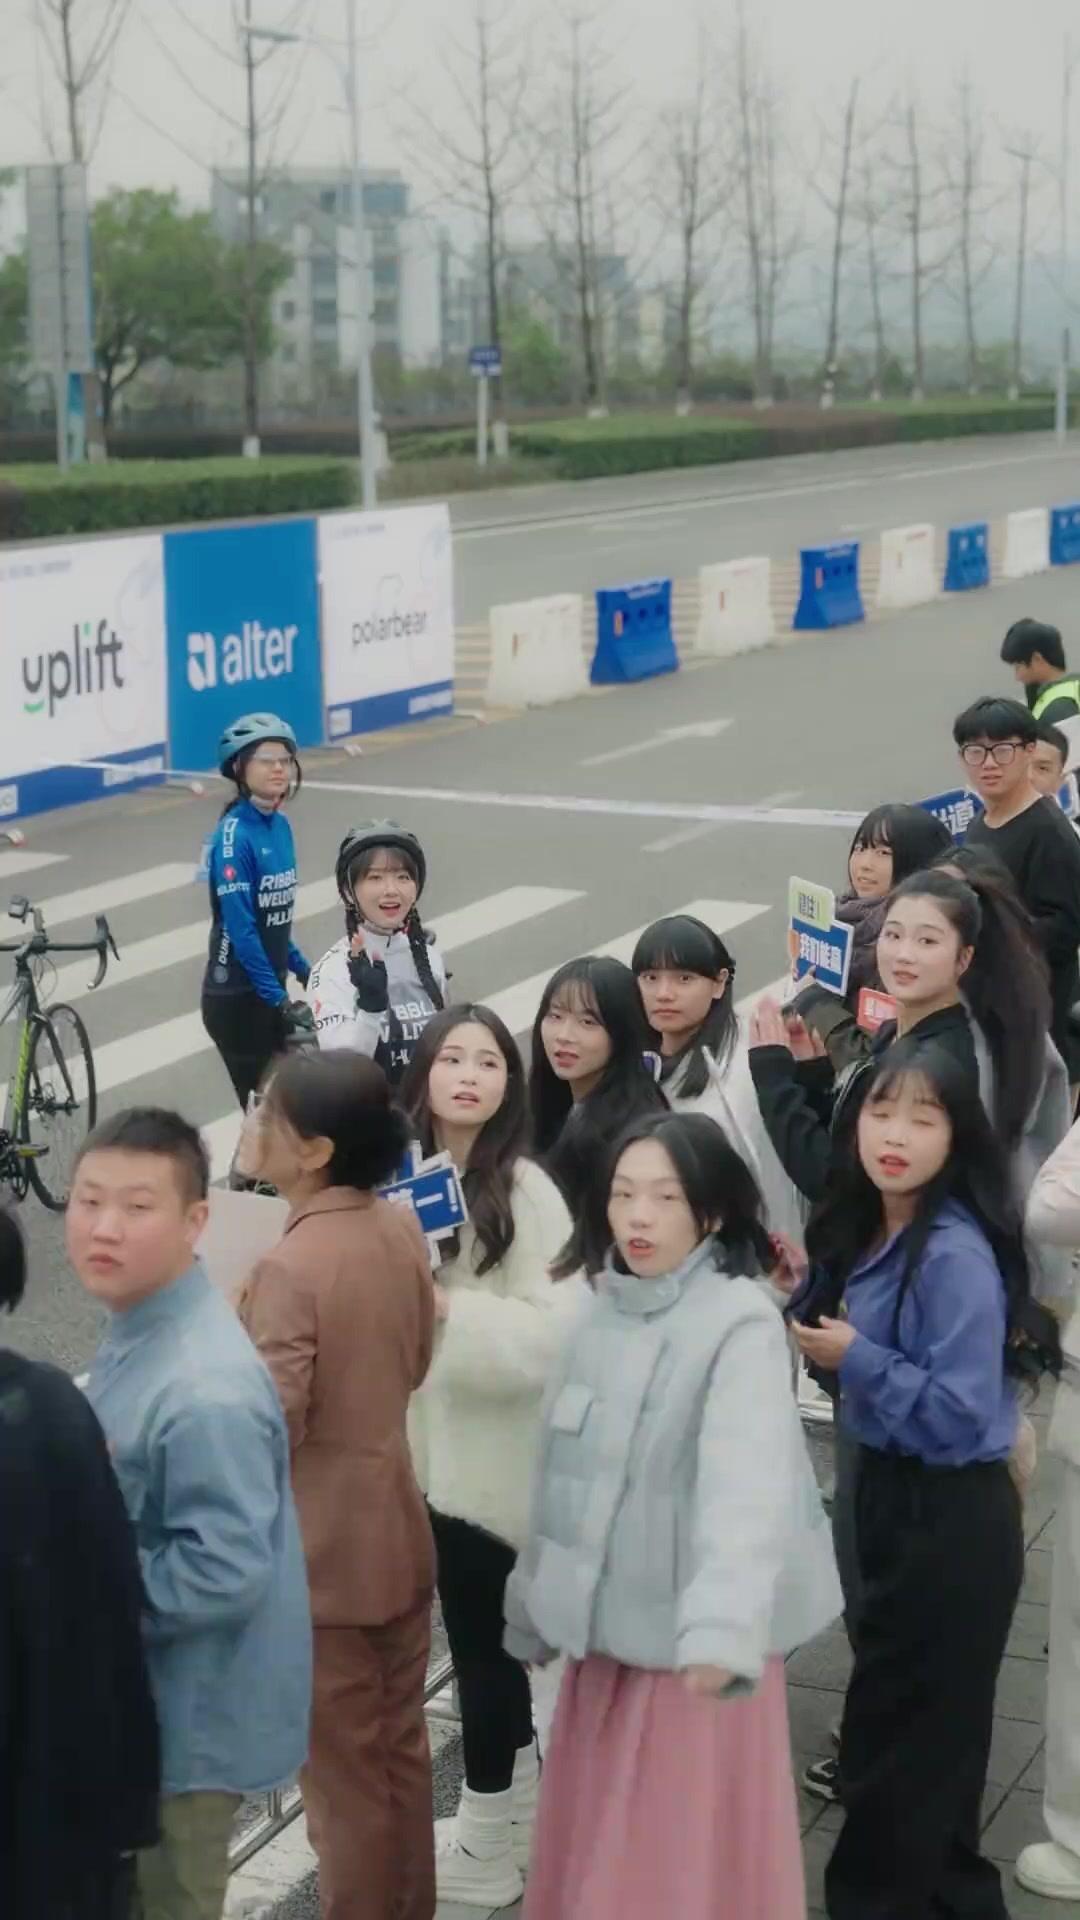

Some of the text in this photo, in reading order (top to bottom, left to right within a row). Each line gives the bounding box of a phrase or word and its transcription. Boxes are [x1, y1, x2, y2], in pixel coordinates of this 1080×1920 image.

[222, 619, 299, 686] alter
[351, 606, 428, 652] polarbear
[22, 618, 125, 719] uplift
